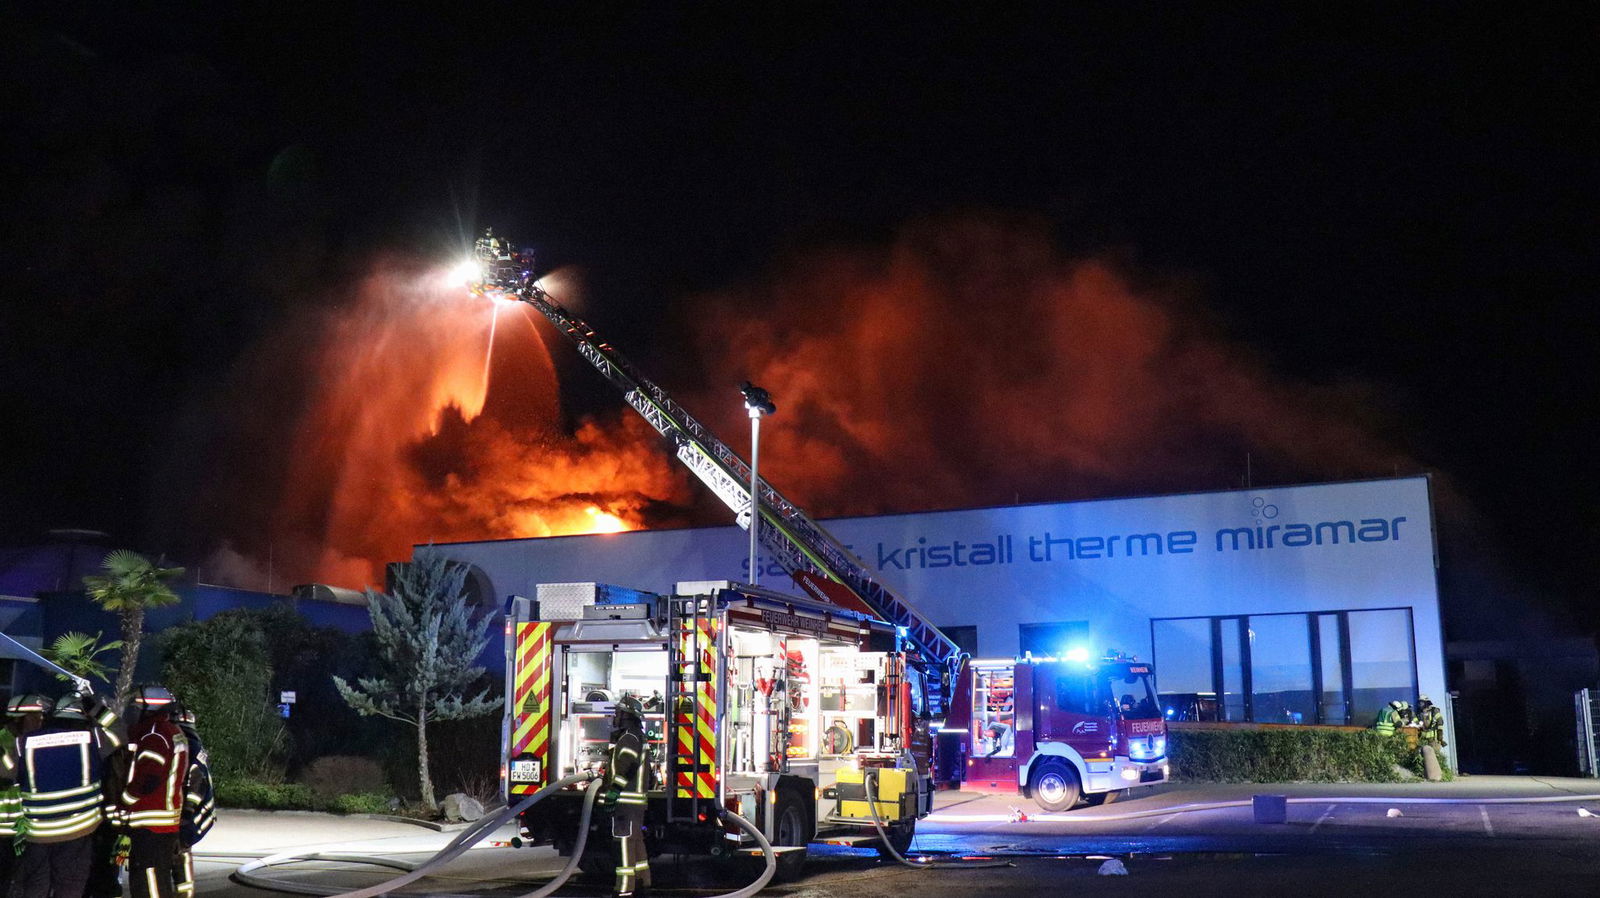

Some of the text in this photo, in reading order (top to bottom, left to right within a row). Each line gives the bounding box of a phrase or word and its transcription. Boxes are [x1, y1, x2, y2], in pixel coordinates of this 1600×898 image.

[877, 535, 1012, 570] kristall
[1029, 530, 1197, 562] therme
[1216, 516, 1407, 551] miramar
[762, 609, 799, 628] FEUERWEHR
